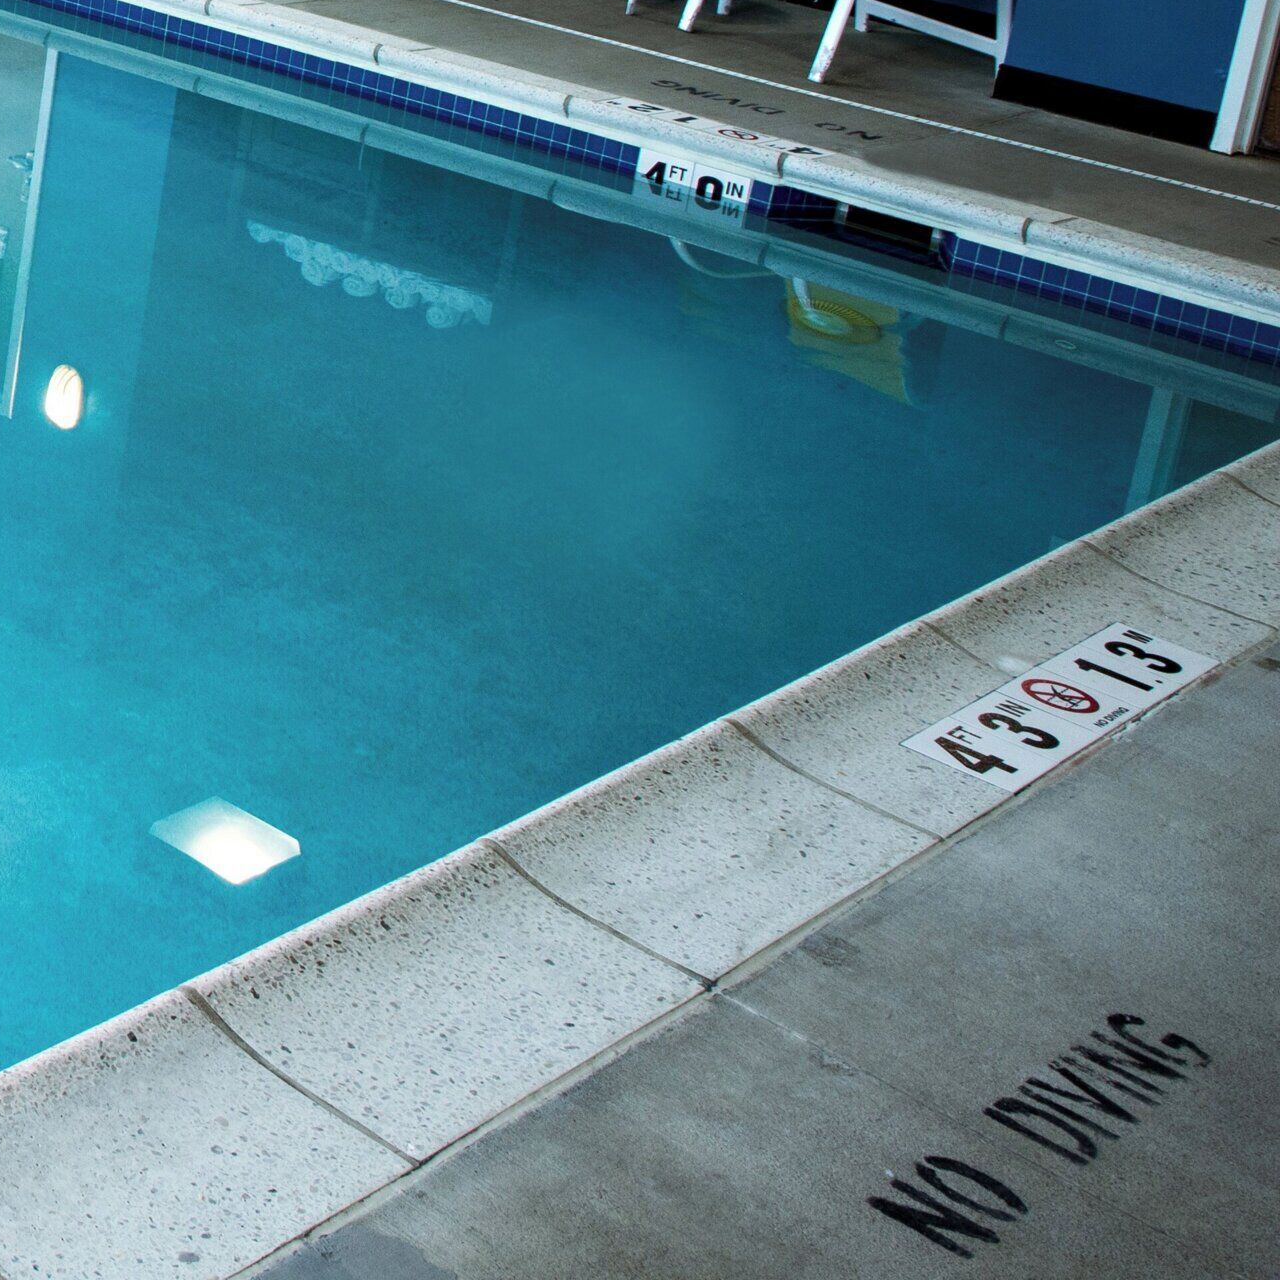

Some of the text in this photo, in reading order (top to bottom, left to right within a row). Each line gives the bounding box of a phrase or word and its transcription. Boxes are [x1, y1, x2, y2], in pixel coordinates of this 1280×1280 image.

[650, 79, 884, 141] NO DIVING
[669, 165, 688, 181] FT
[696, 175, 724, 206] 0
[726, 181, 744, 199] IN
[933, 629, 1183, 774] 4 FT 3 IN 1.3 M
[1094, 706, 1130, 728] NO DIVING
[867, 1012, 1212, 1259] NO DIVING
